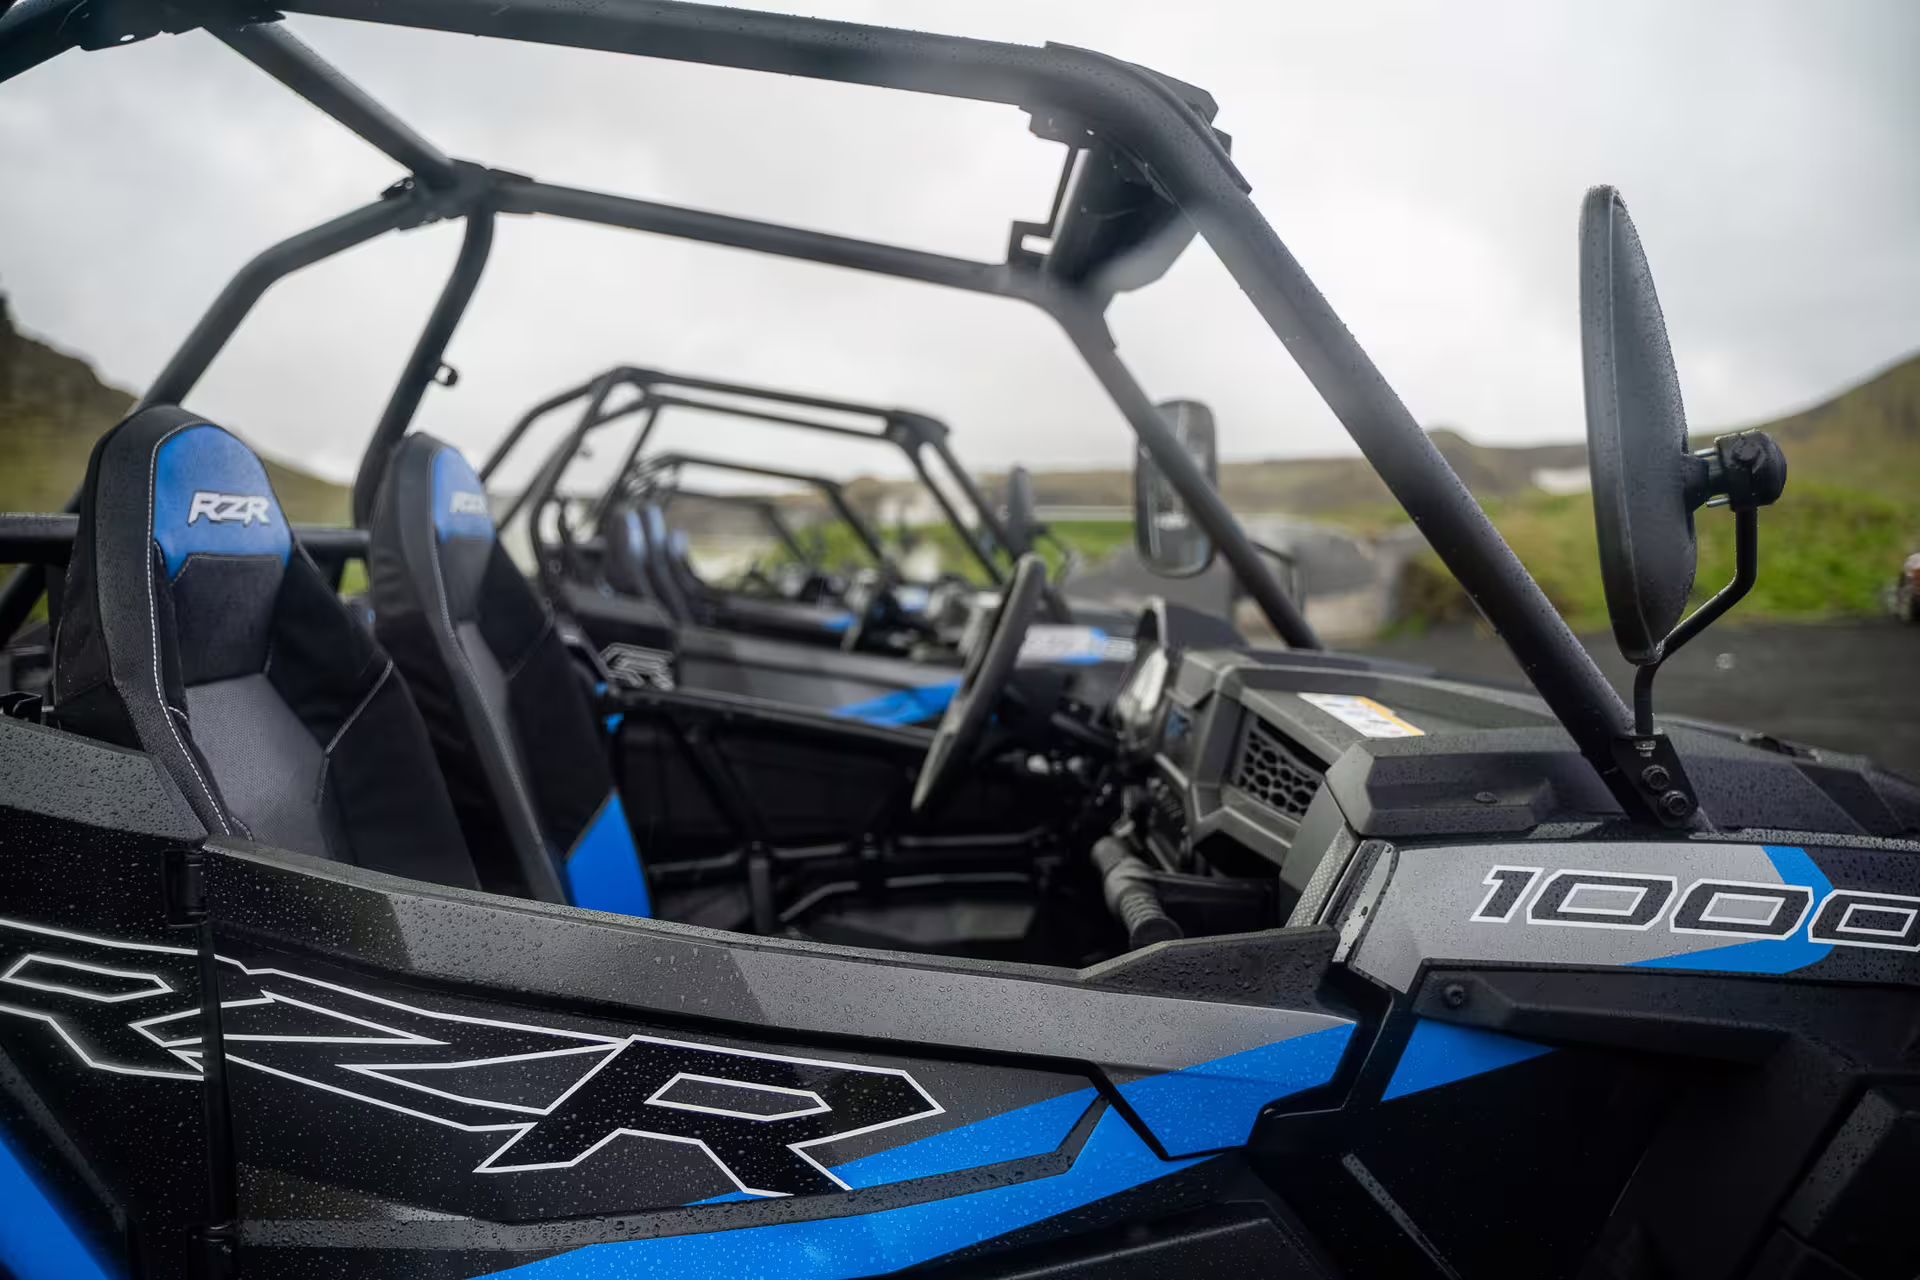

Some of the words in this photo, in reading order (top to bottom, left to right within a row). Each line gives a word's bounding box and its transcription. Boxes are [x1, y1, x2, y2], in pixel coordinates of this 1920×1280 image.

[187, 491, 270, 527] RZR
[1469, 864, 1920, 952] 1000
[0, 919, 946, 1197] RZR
